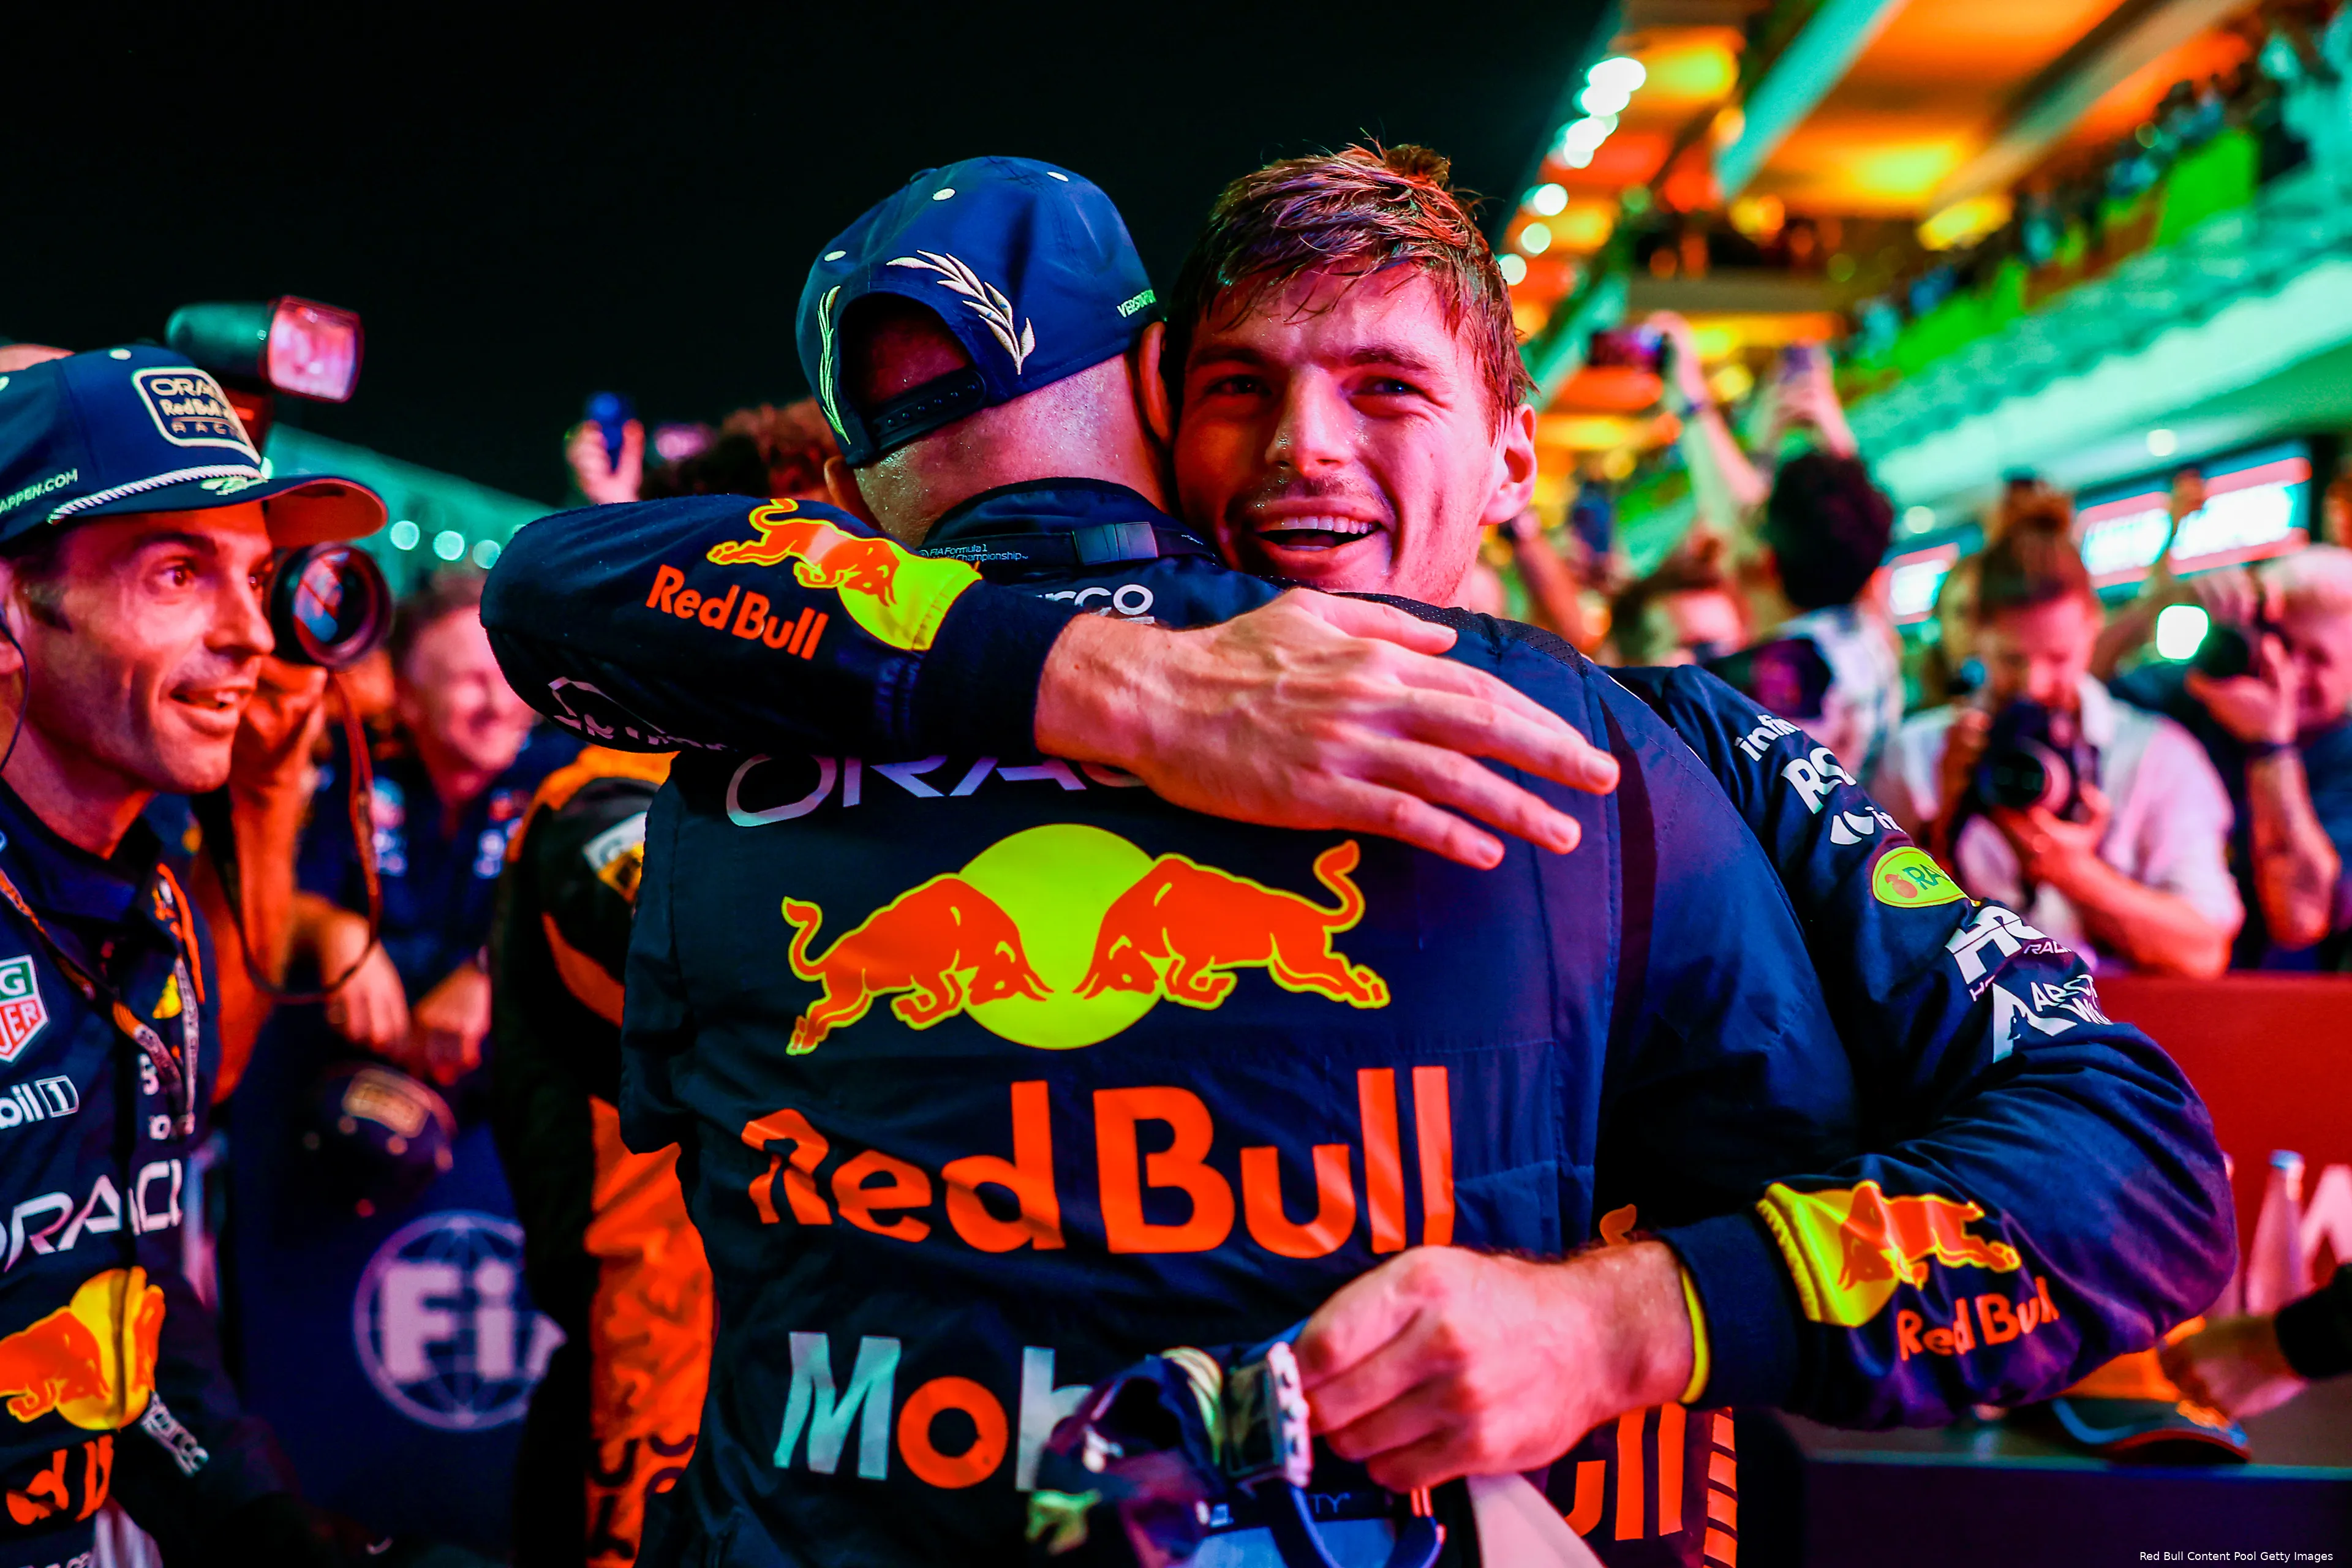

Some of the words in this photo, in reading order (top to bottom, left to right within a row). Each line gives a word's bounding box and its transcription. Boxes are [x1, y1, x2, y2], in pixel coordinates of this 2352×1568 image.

[646, 564, 740, 631] Red
[733, 591, 829, 660] Bull
[741, 1108, 1065, 1253] Red
[1093, 1066, 1455, 1259] Bull
[1897, 1297, 1976, 1361] Red
